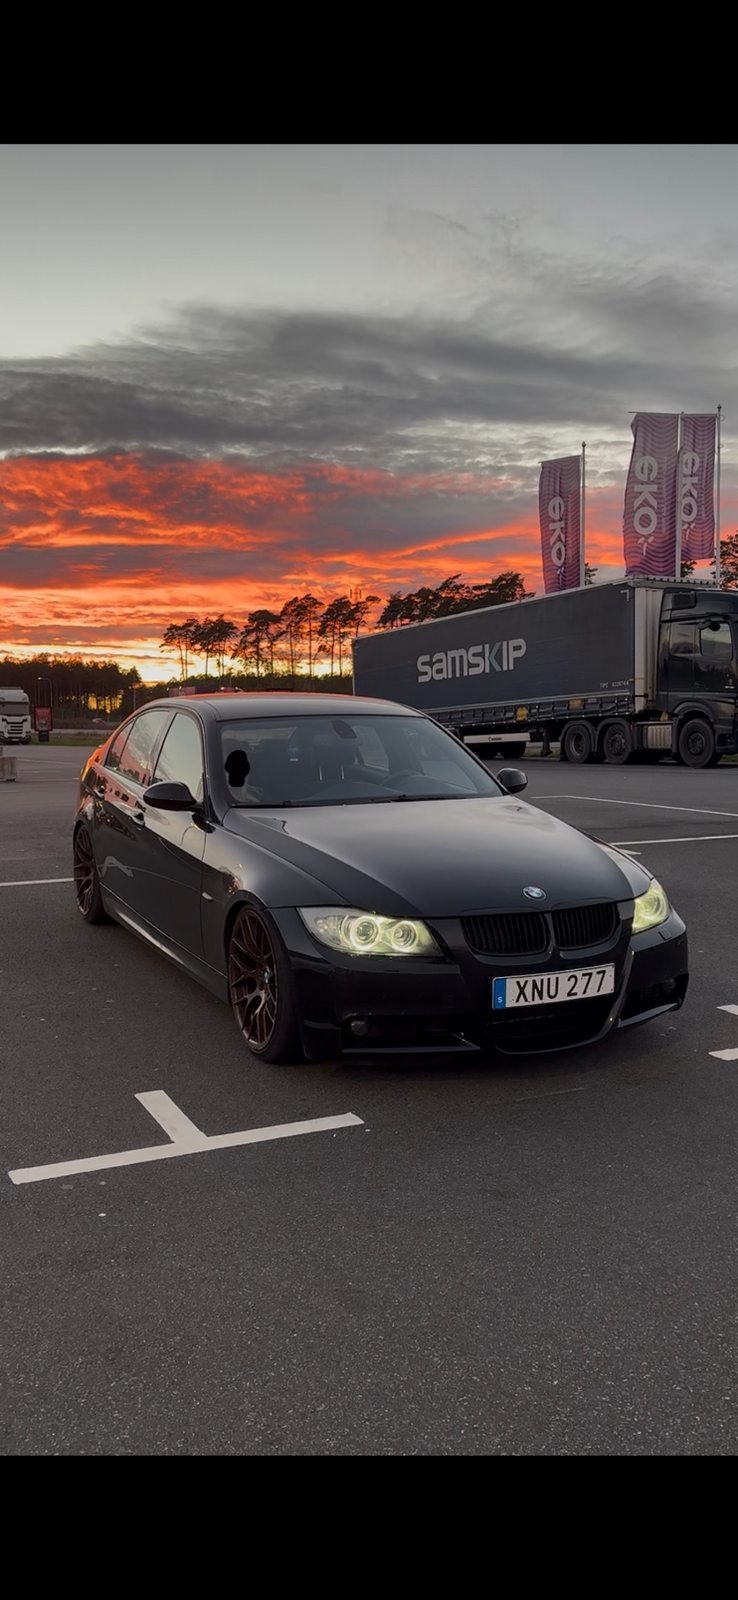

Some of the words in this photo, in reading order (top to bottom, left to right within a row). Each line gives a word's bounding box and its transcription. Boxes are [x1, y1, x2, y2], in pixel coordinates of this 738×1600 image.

[497, 996, 503, 1004] S
[515, 976, 559, 1003] XNU
[566, 969, 607, 997] 277
